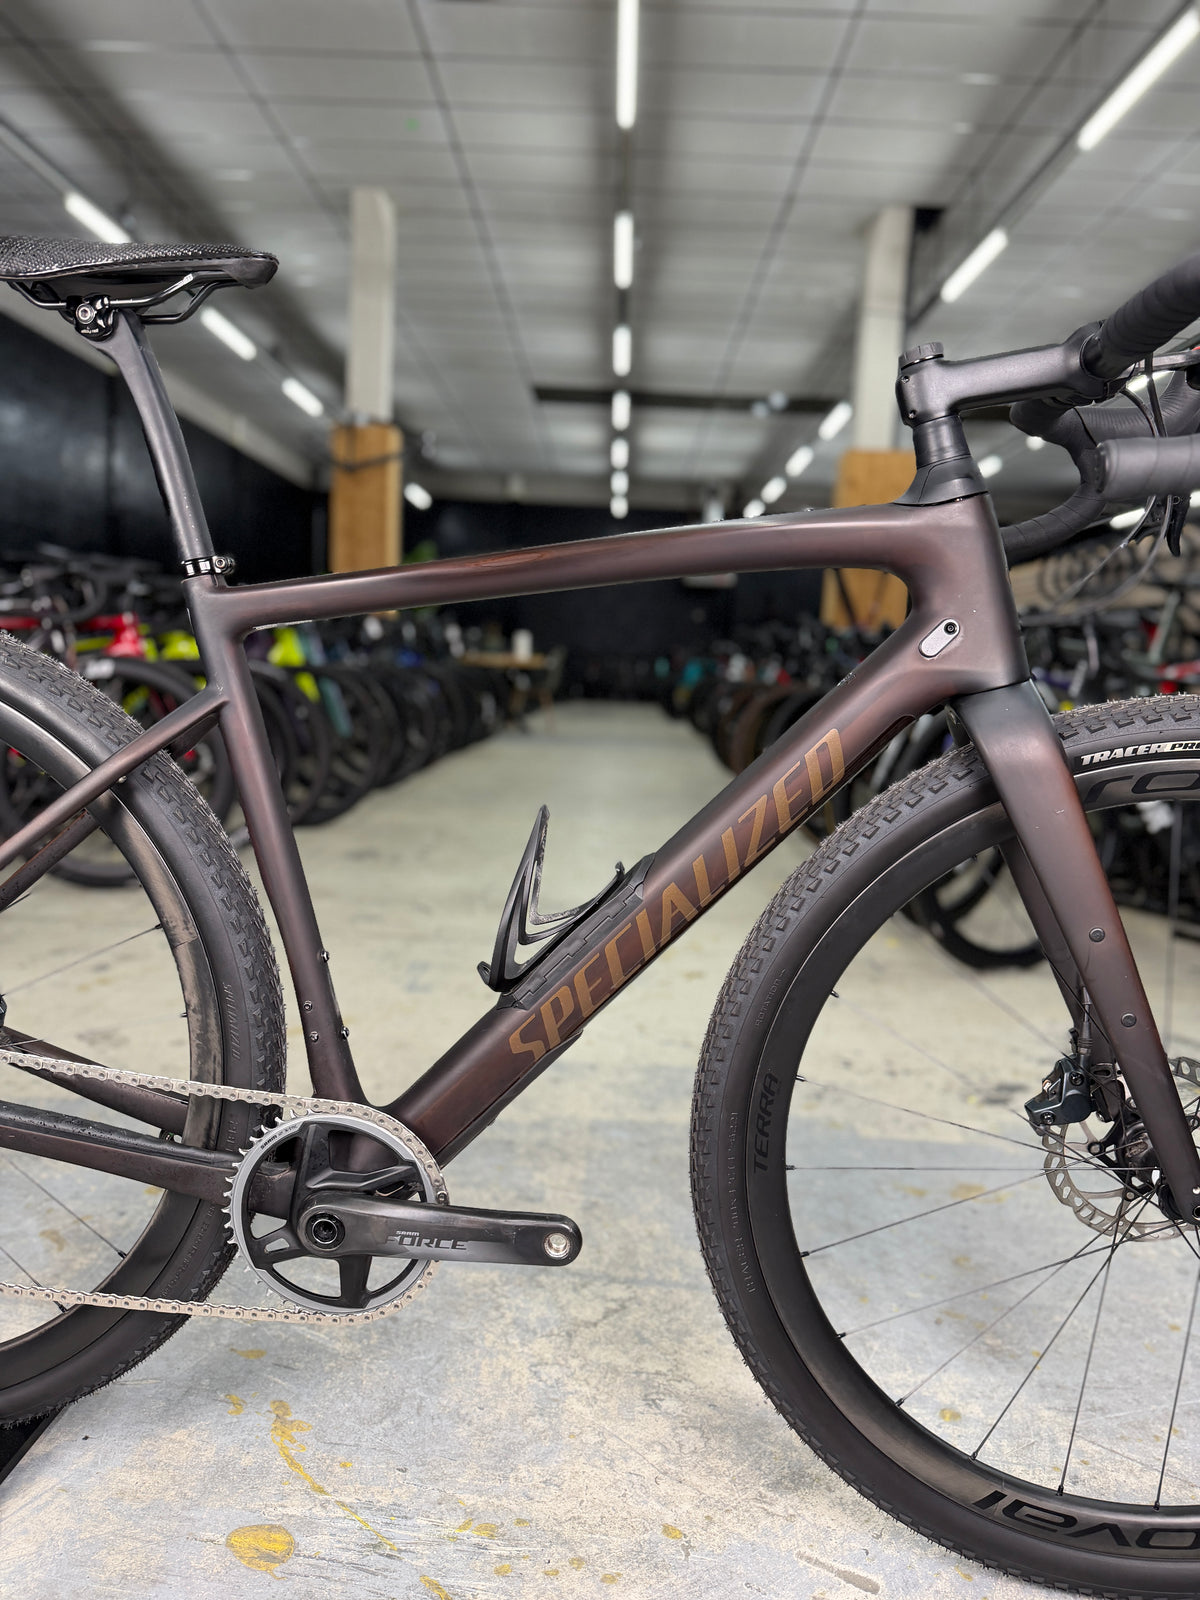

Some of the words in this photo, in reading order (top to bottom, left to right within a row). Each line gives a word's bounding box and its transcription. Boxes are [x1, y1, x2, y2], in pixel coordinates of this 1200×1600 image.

[1081, 743, 1168, 766] TRACER
[508, 728, 846, 1062] SPECIALIZED
[753, 1072, 778, 1174] TERRA
[384, 1235, 467, 1250] FORCE
